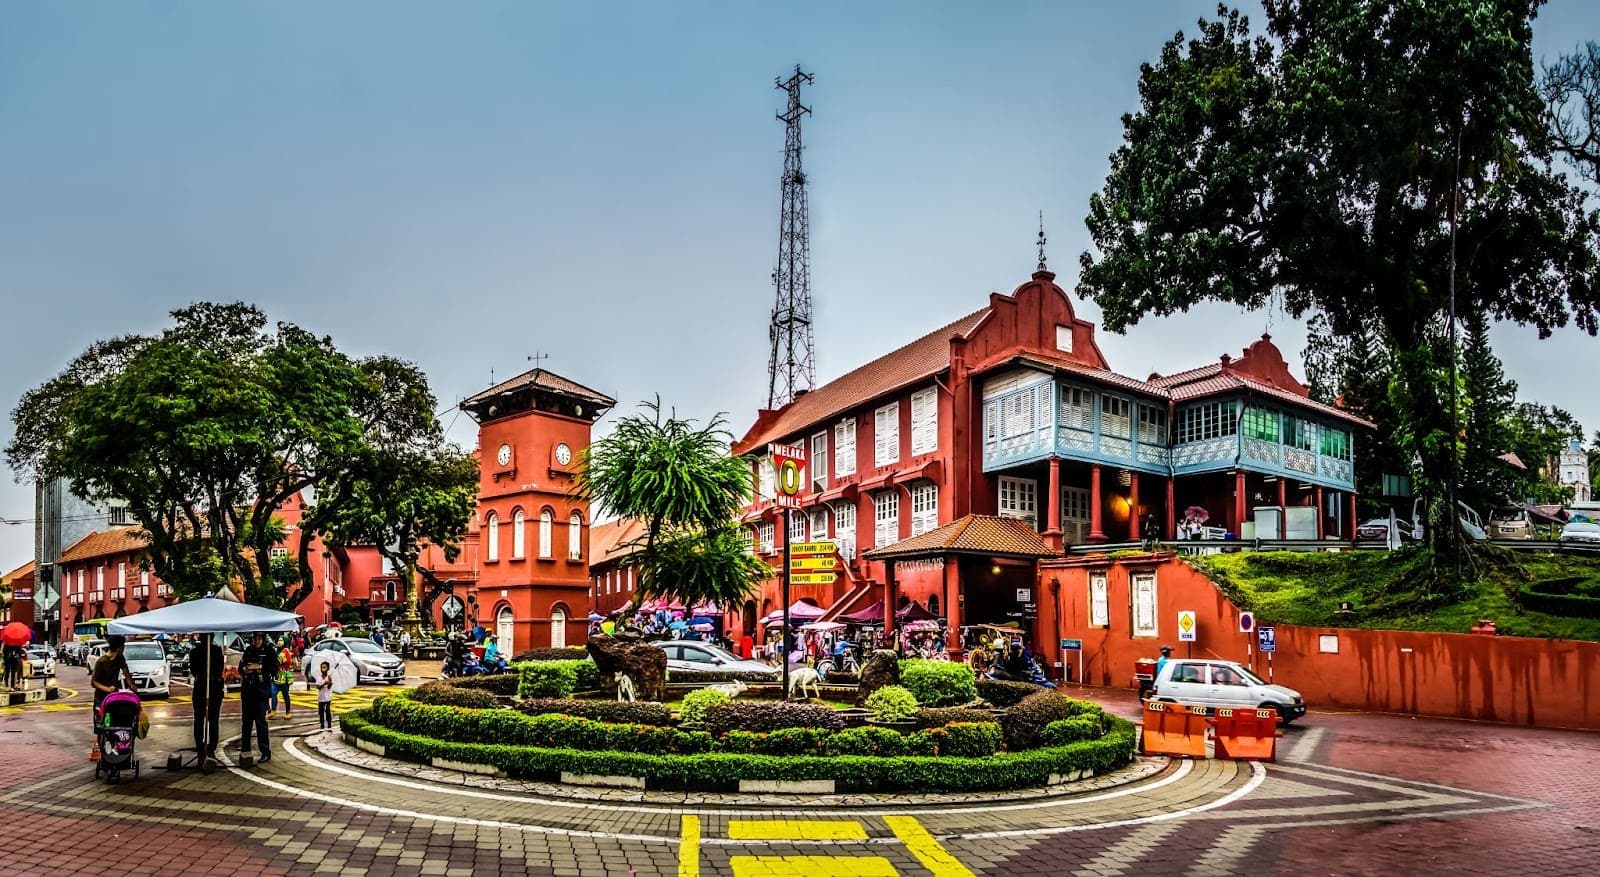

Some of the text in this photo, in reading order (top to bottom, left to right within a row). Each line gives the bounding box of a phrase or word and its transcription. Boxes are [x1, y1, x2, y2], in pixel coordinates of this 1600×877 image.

[774, 444, 805, 460] MELAKA
[781, 459, 799, 495] 0
[778, 495, 801, 508] MILE
